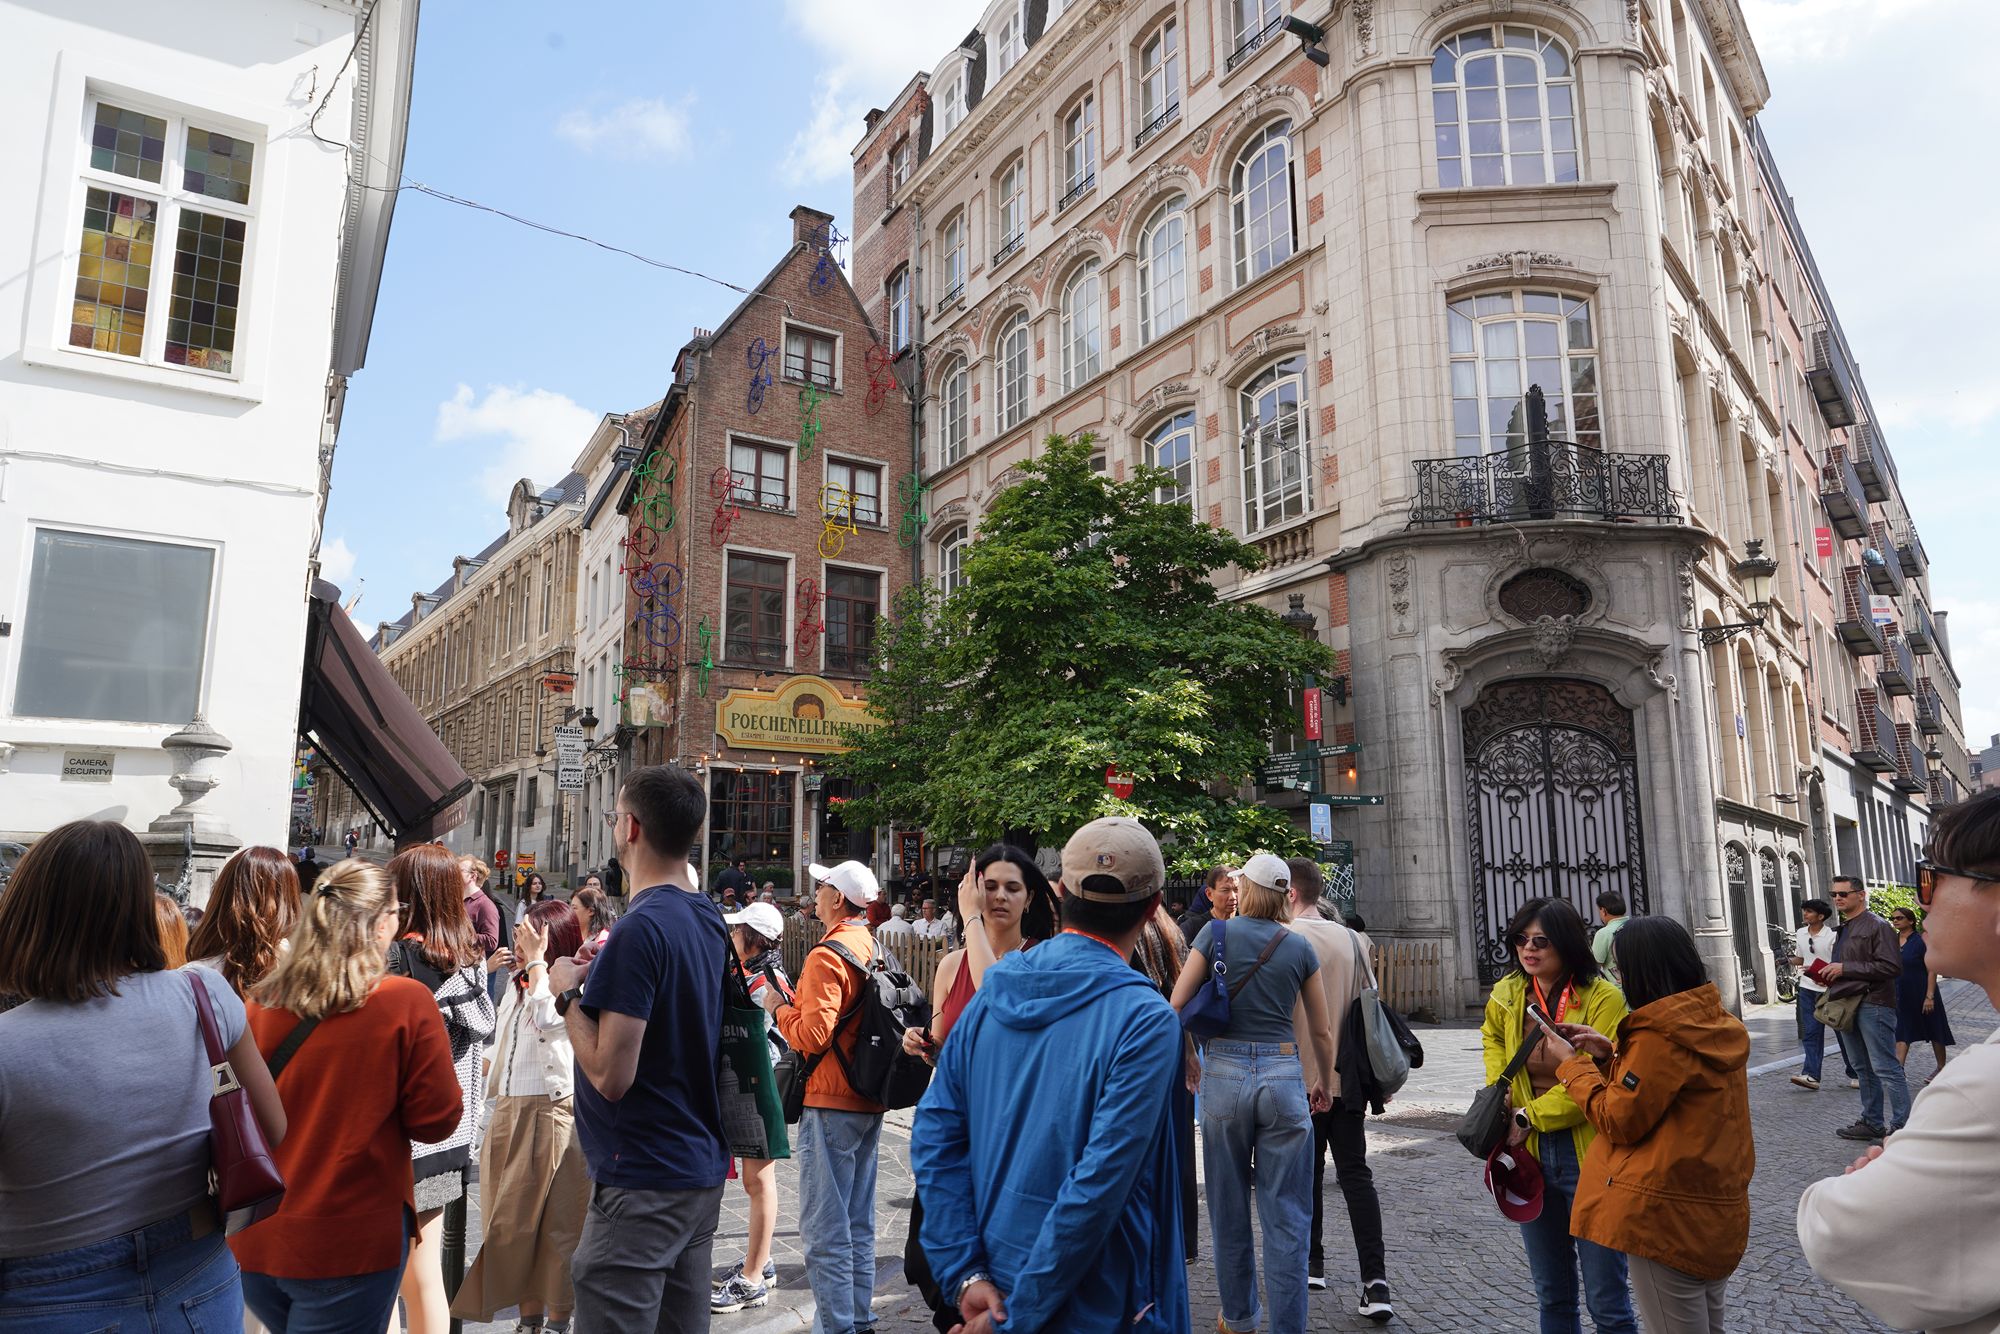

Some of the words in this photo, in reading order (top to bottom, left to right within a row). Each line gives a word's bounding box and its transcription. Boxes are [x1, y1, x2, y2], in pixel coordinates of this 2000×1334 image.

[554, 726, 583, 735] Music
[774, 734, 791, 742] LEGEND
[69, 758, 108, 767] CAMERA
[722, 1025, 748, 1038] BLIN
